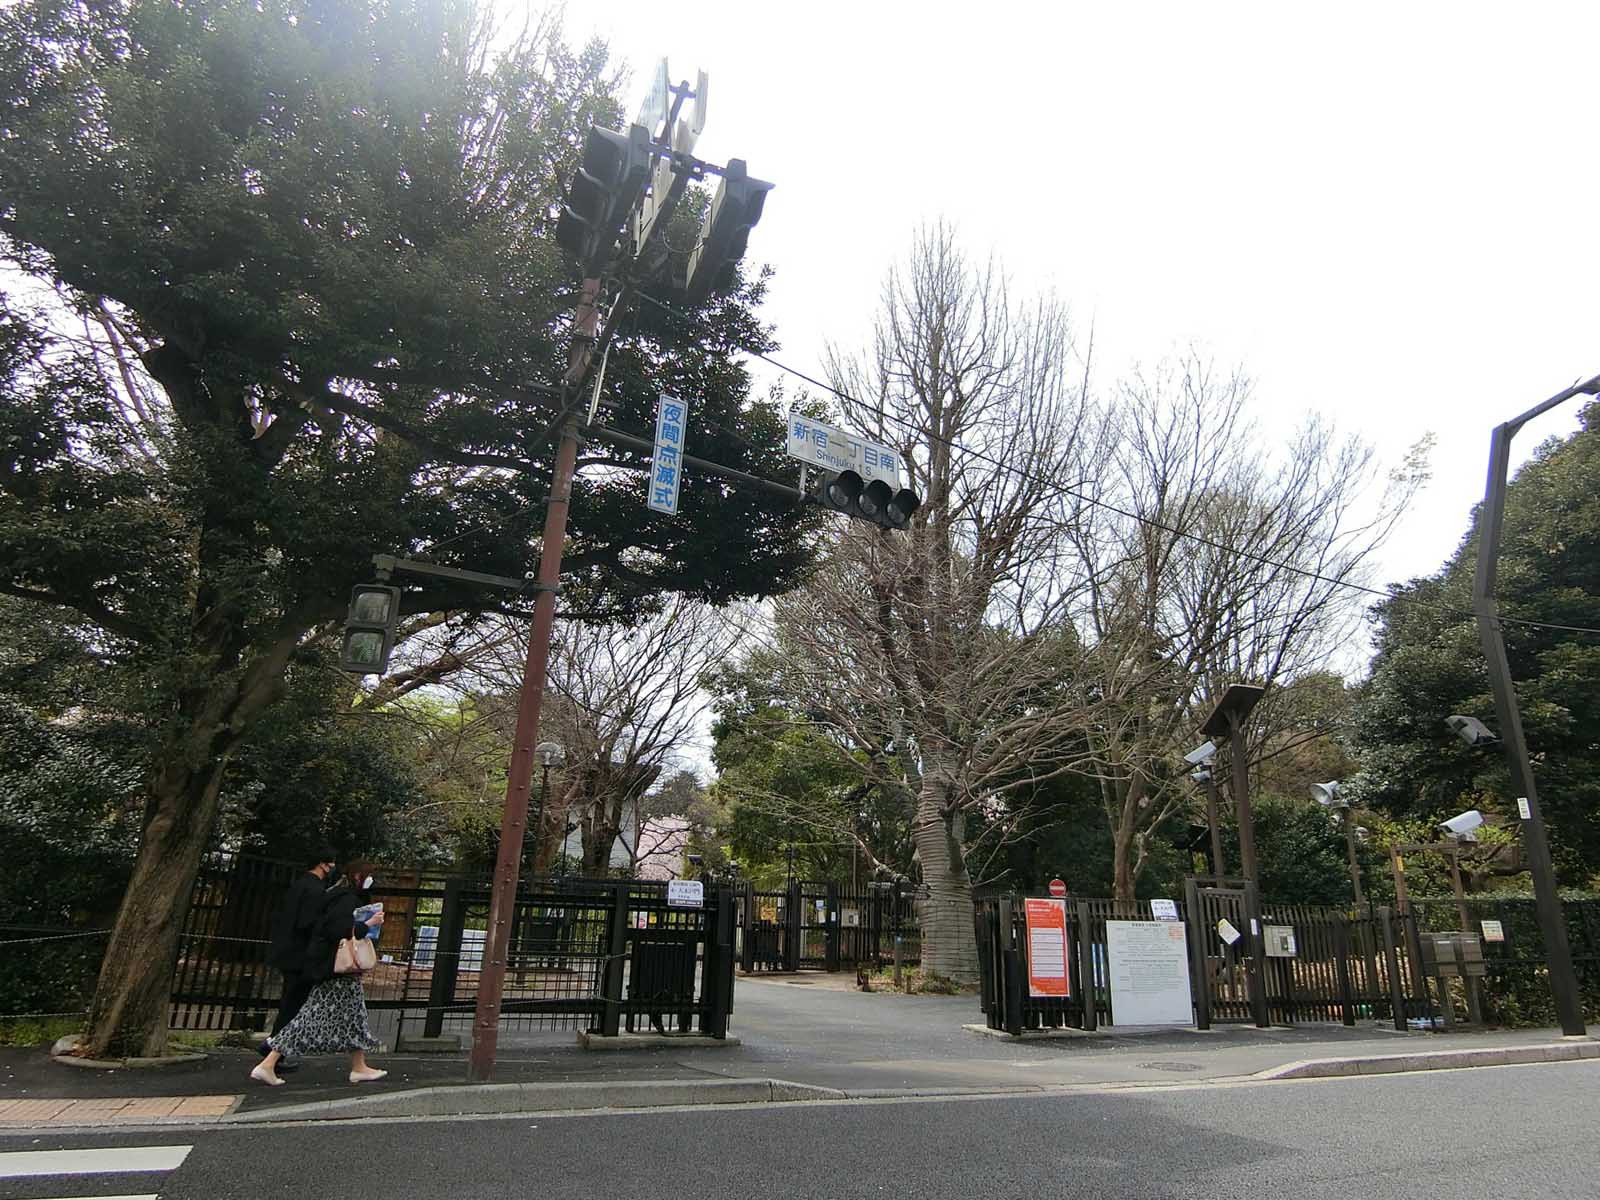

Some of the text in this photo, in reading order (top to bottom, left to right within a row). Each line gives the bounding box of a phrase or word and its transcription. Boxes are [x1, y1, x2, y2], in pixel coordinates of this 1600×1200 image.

[653, 403, 683, 508] 夜間点滅式
[793, 421, 895, 473] 新宿一丁目南
[816, 449, 855, 470] Shinjuku
